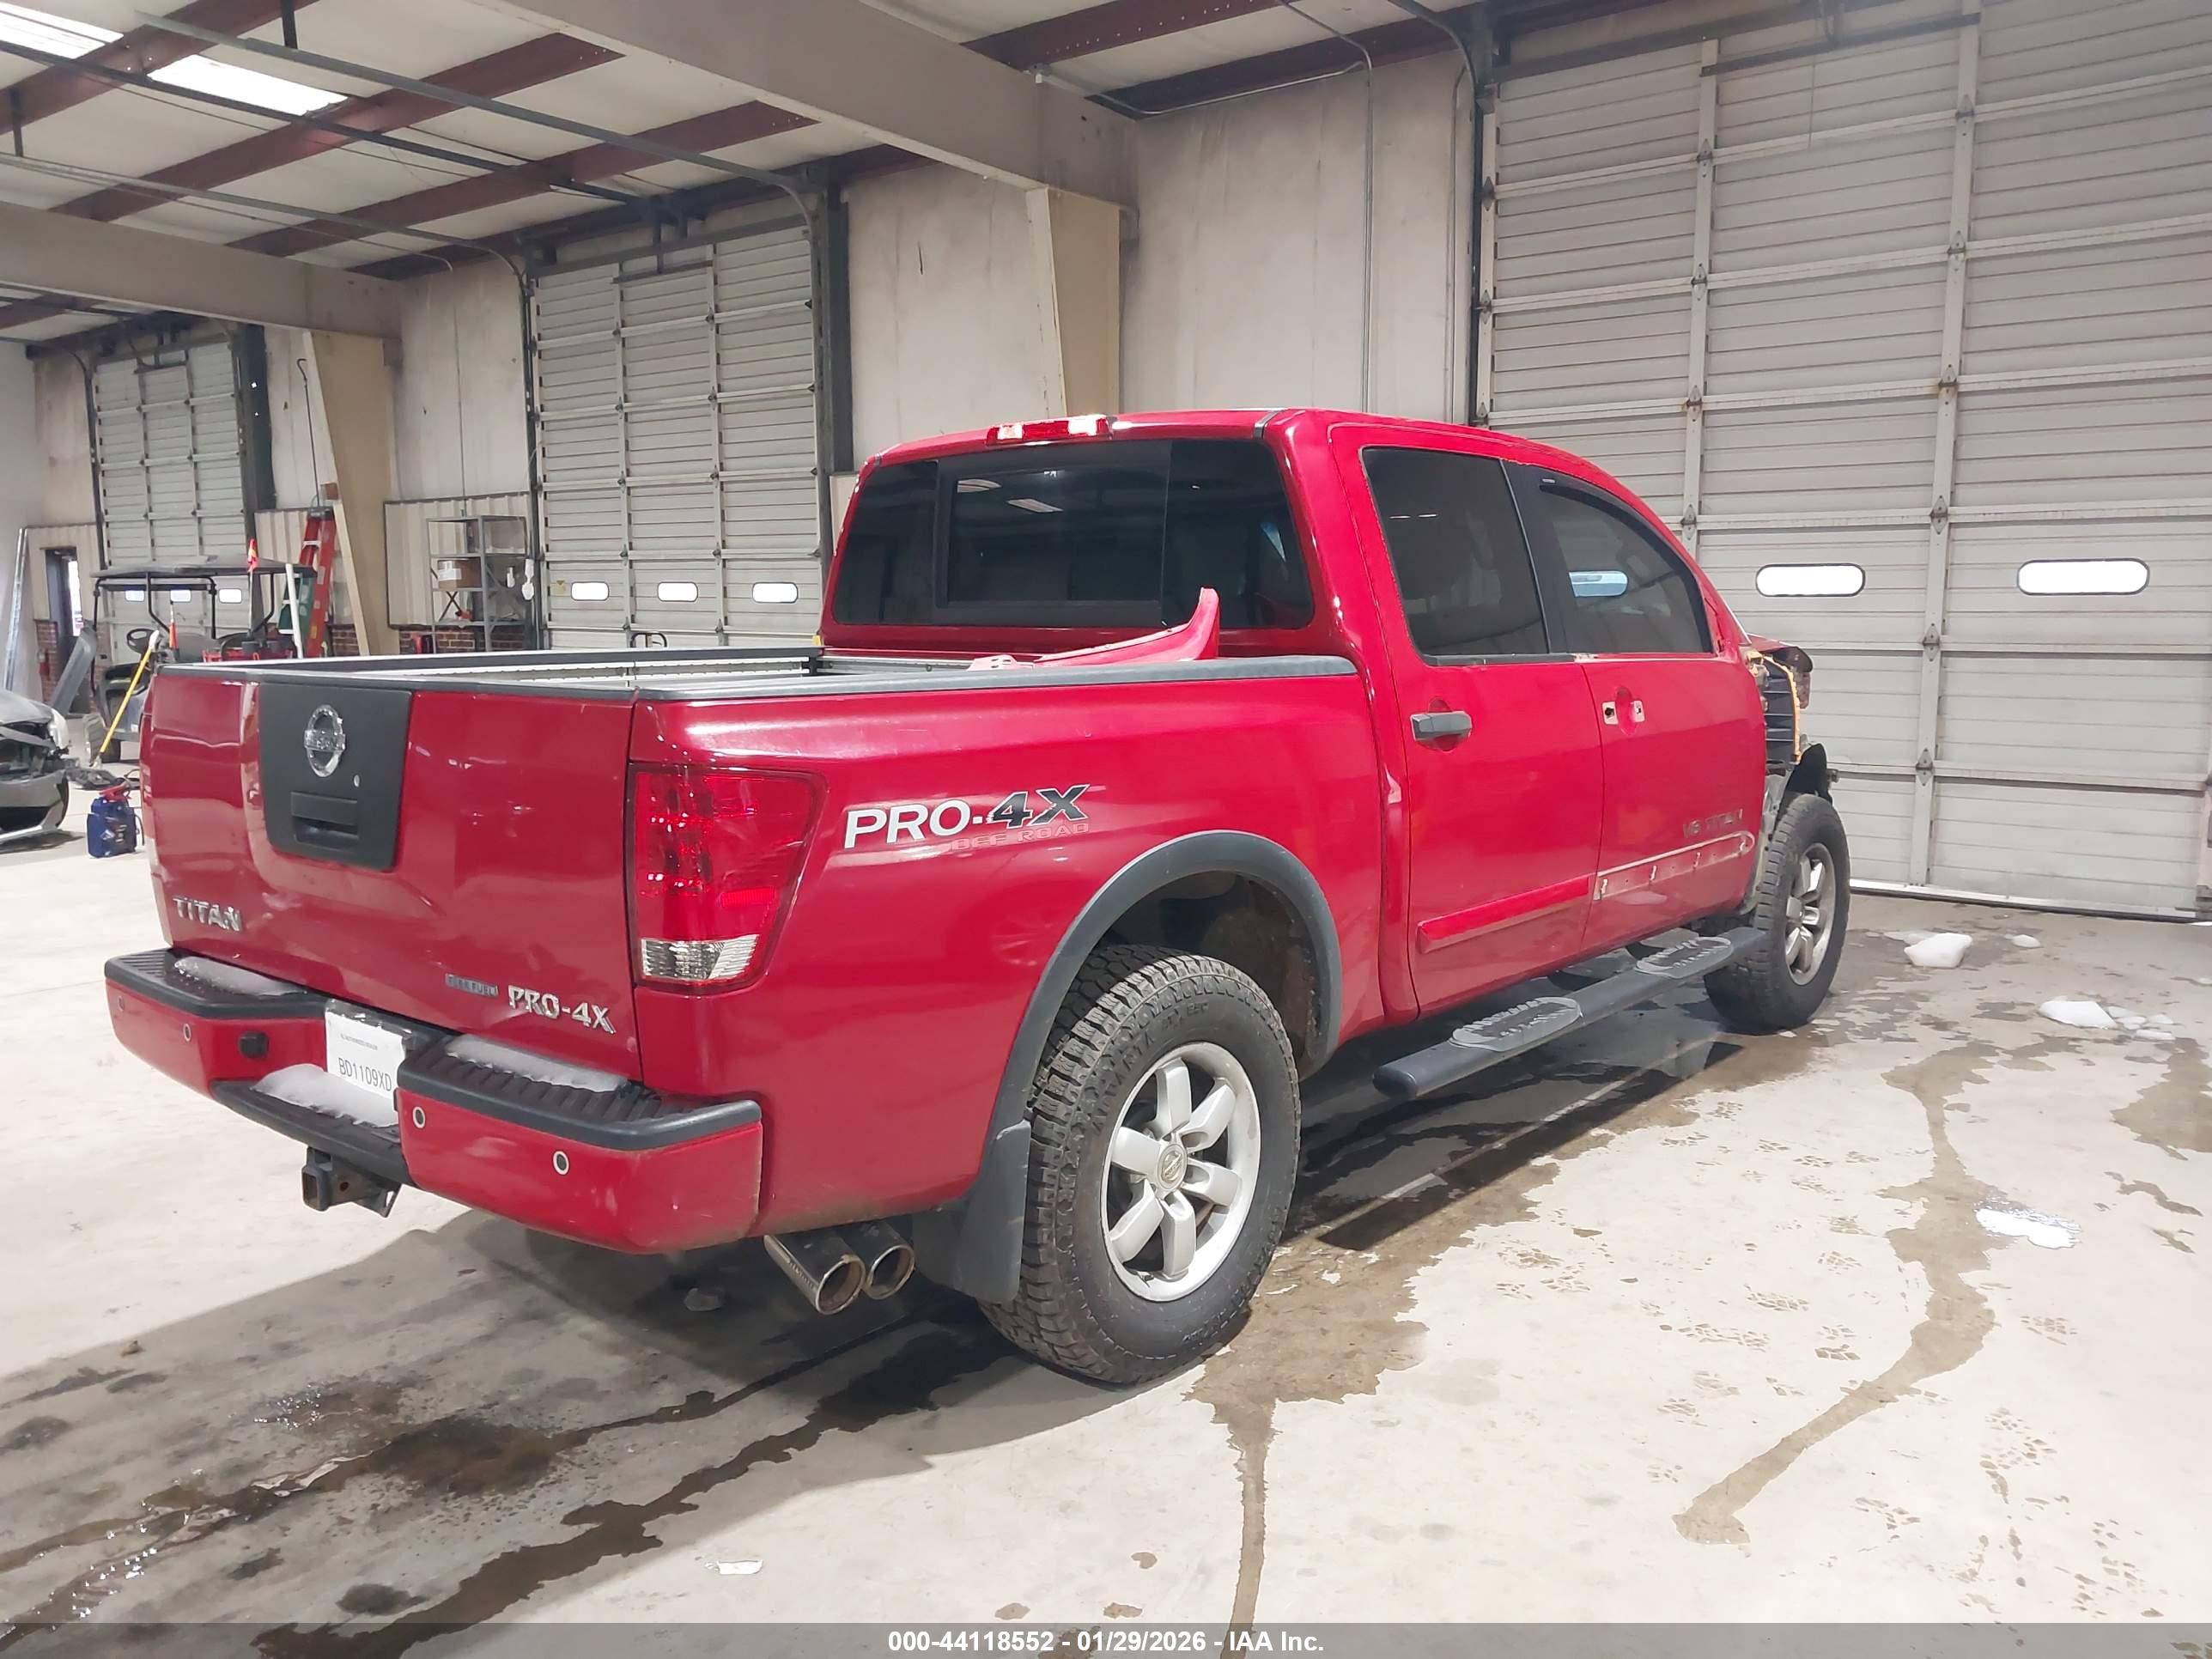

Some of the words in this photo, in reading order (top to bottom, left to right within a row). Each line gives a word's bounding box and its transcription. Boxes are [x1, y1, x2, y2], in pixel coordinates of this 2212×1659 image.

[1017, 822, 1089, 842] ROAD
[172, 895, 242, 932] TITAN
[507, 984, 617, 1035] PRO-4X
[337, 1057, 392, 1091] BD1109XD
